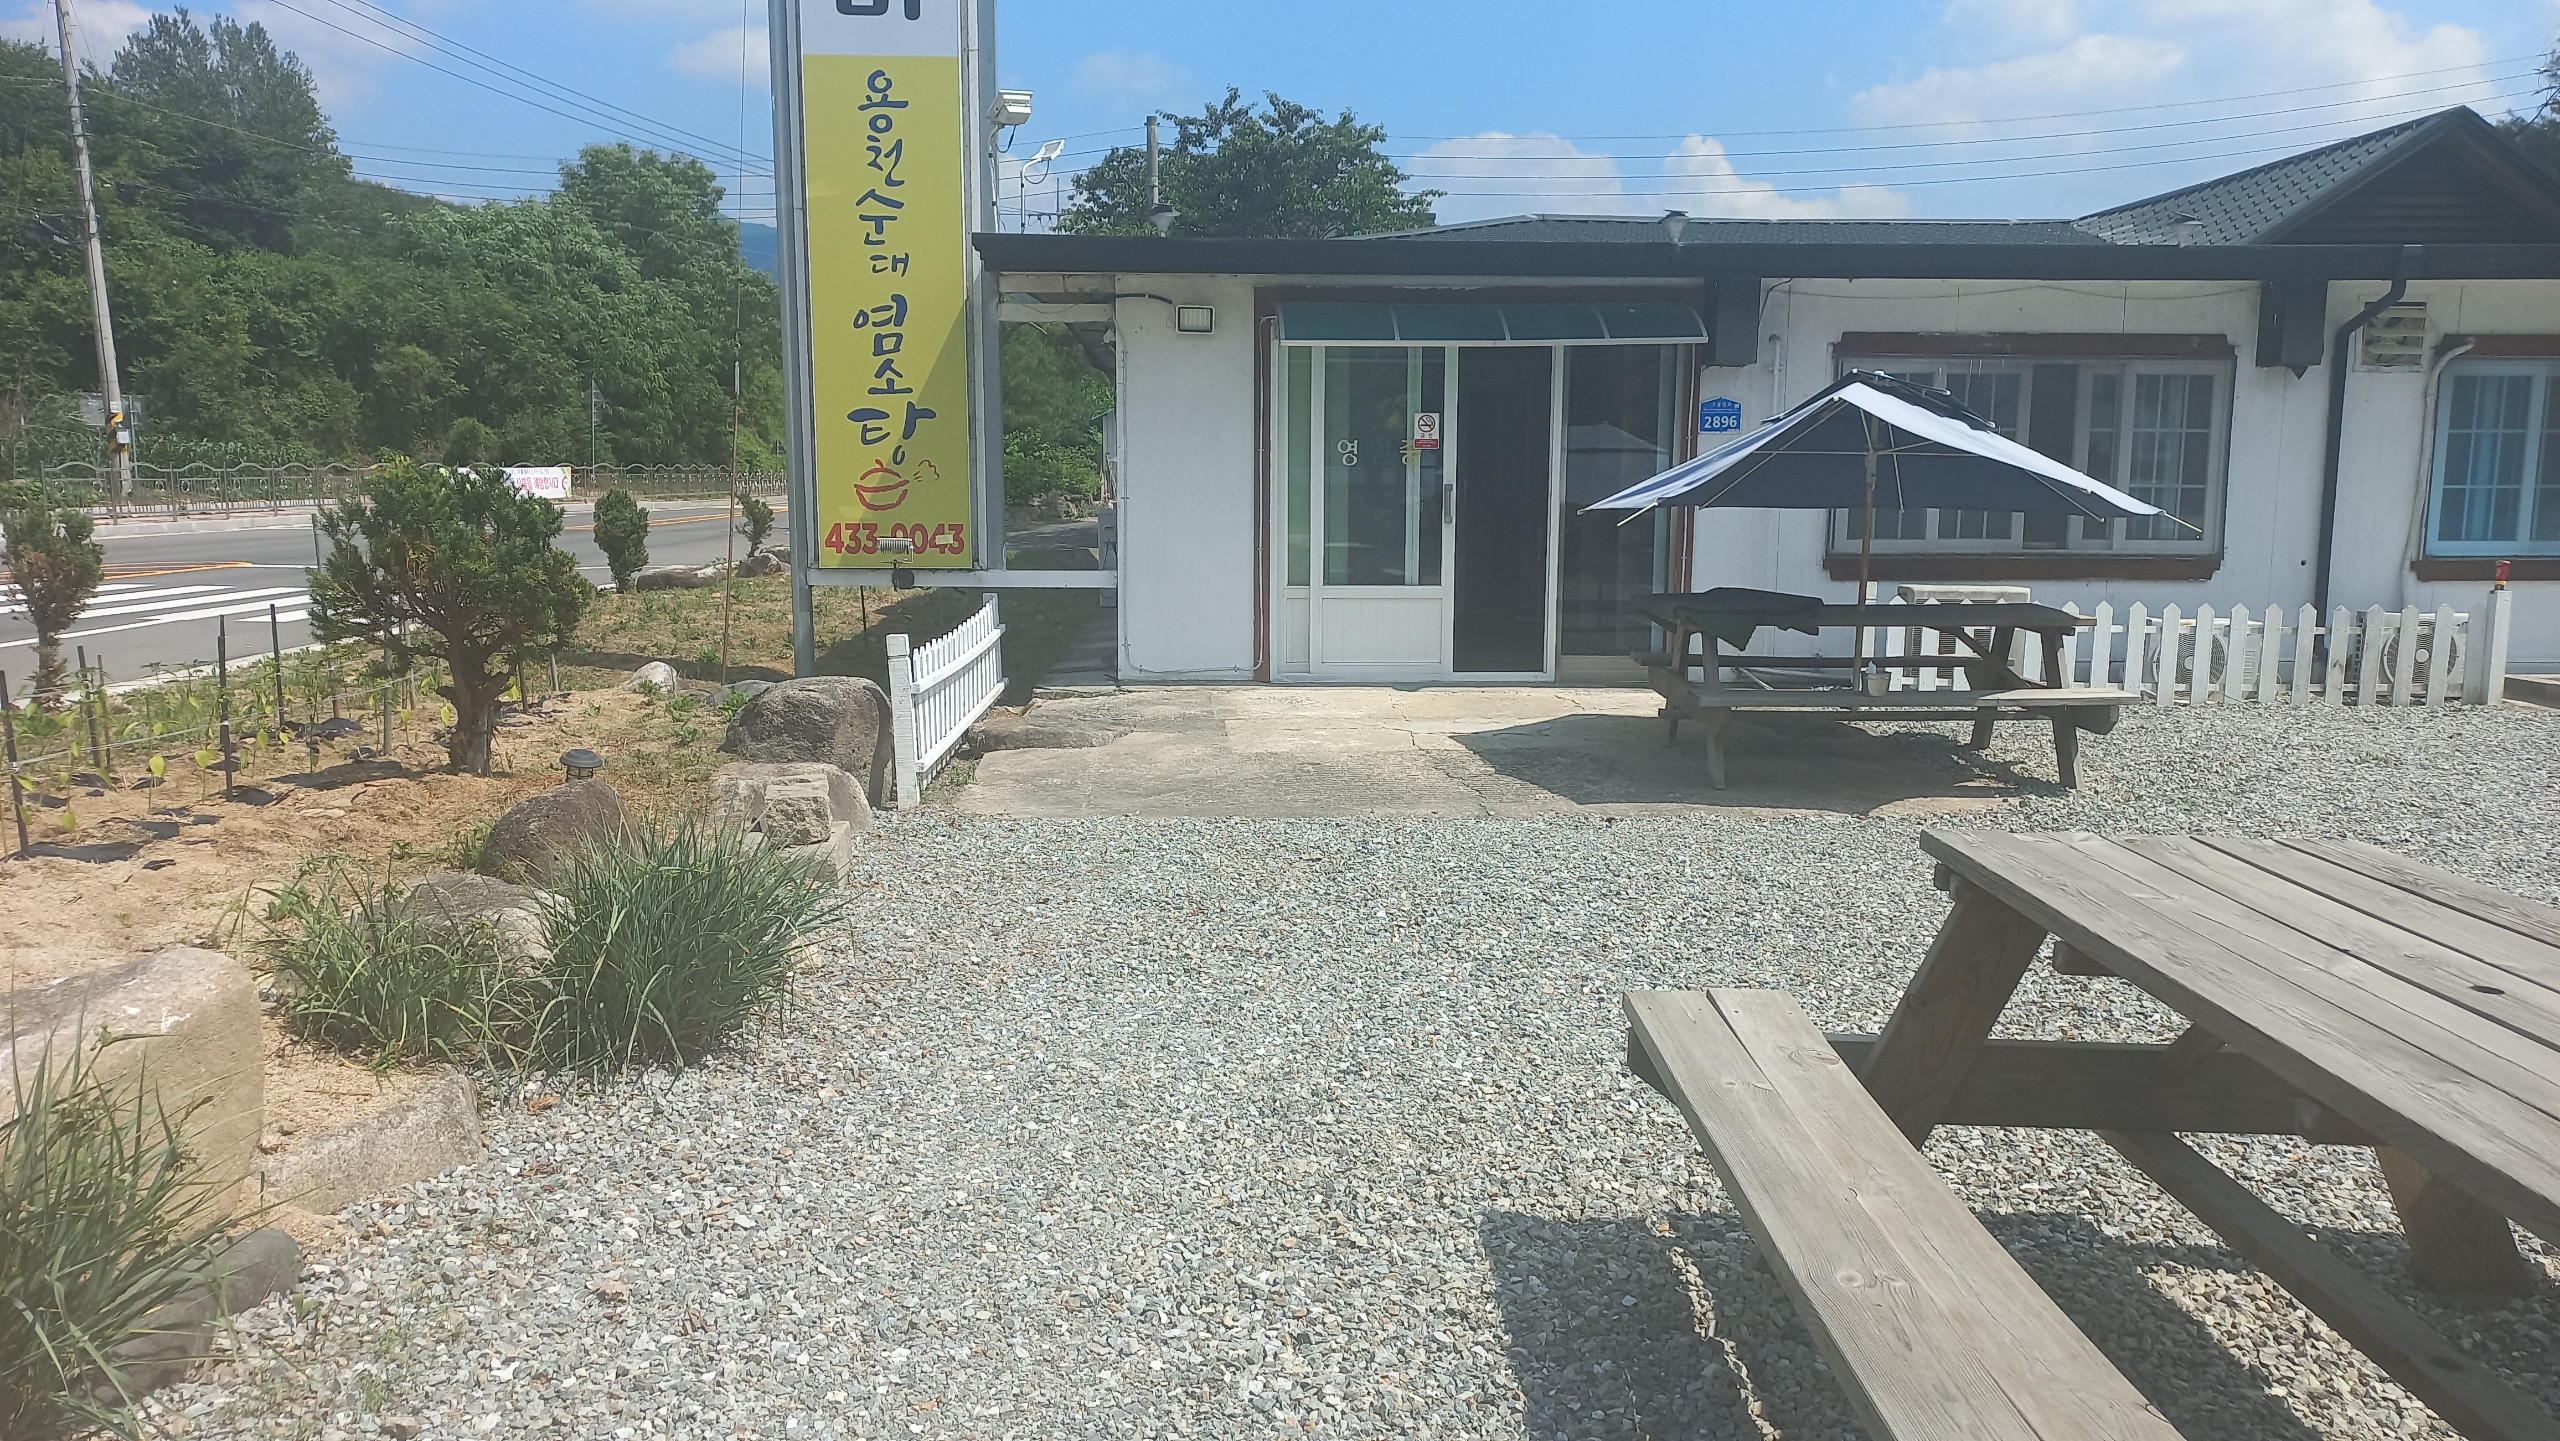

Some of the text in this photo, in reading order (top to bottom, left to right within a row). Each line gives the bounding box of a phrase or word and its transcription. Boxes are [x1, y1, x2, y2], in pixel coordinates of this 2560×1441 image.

[846, 293, 937, 466] 염소탕
[1704, 415, 1737, 428] 2896
[824, 522, 965, 555] 4330043
